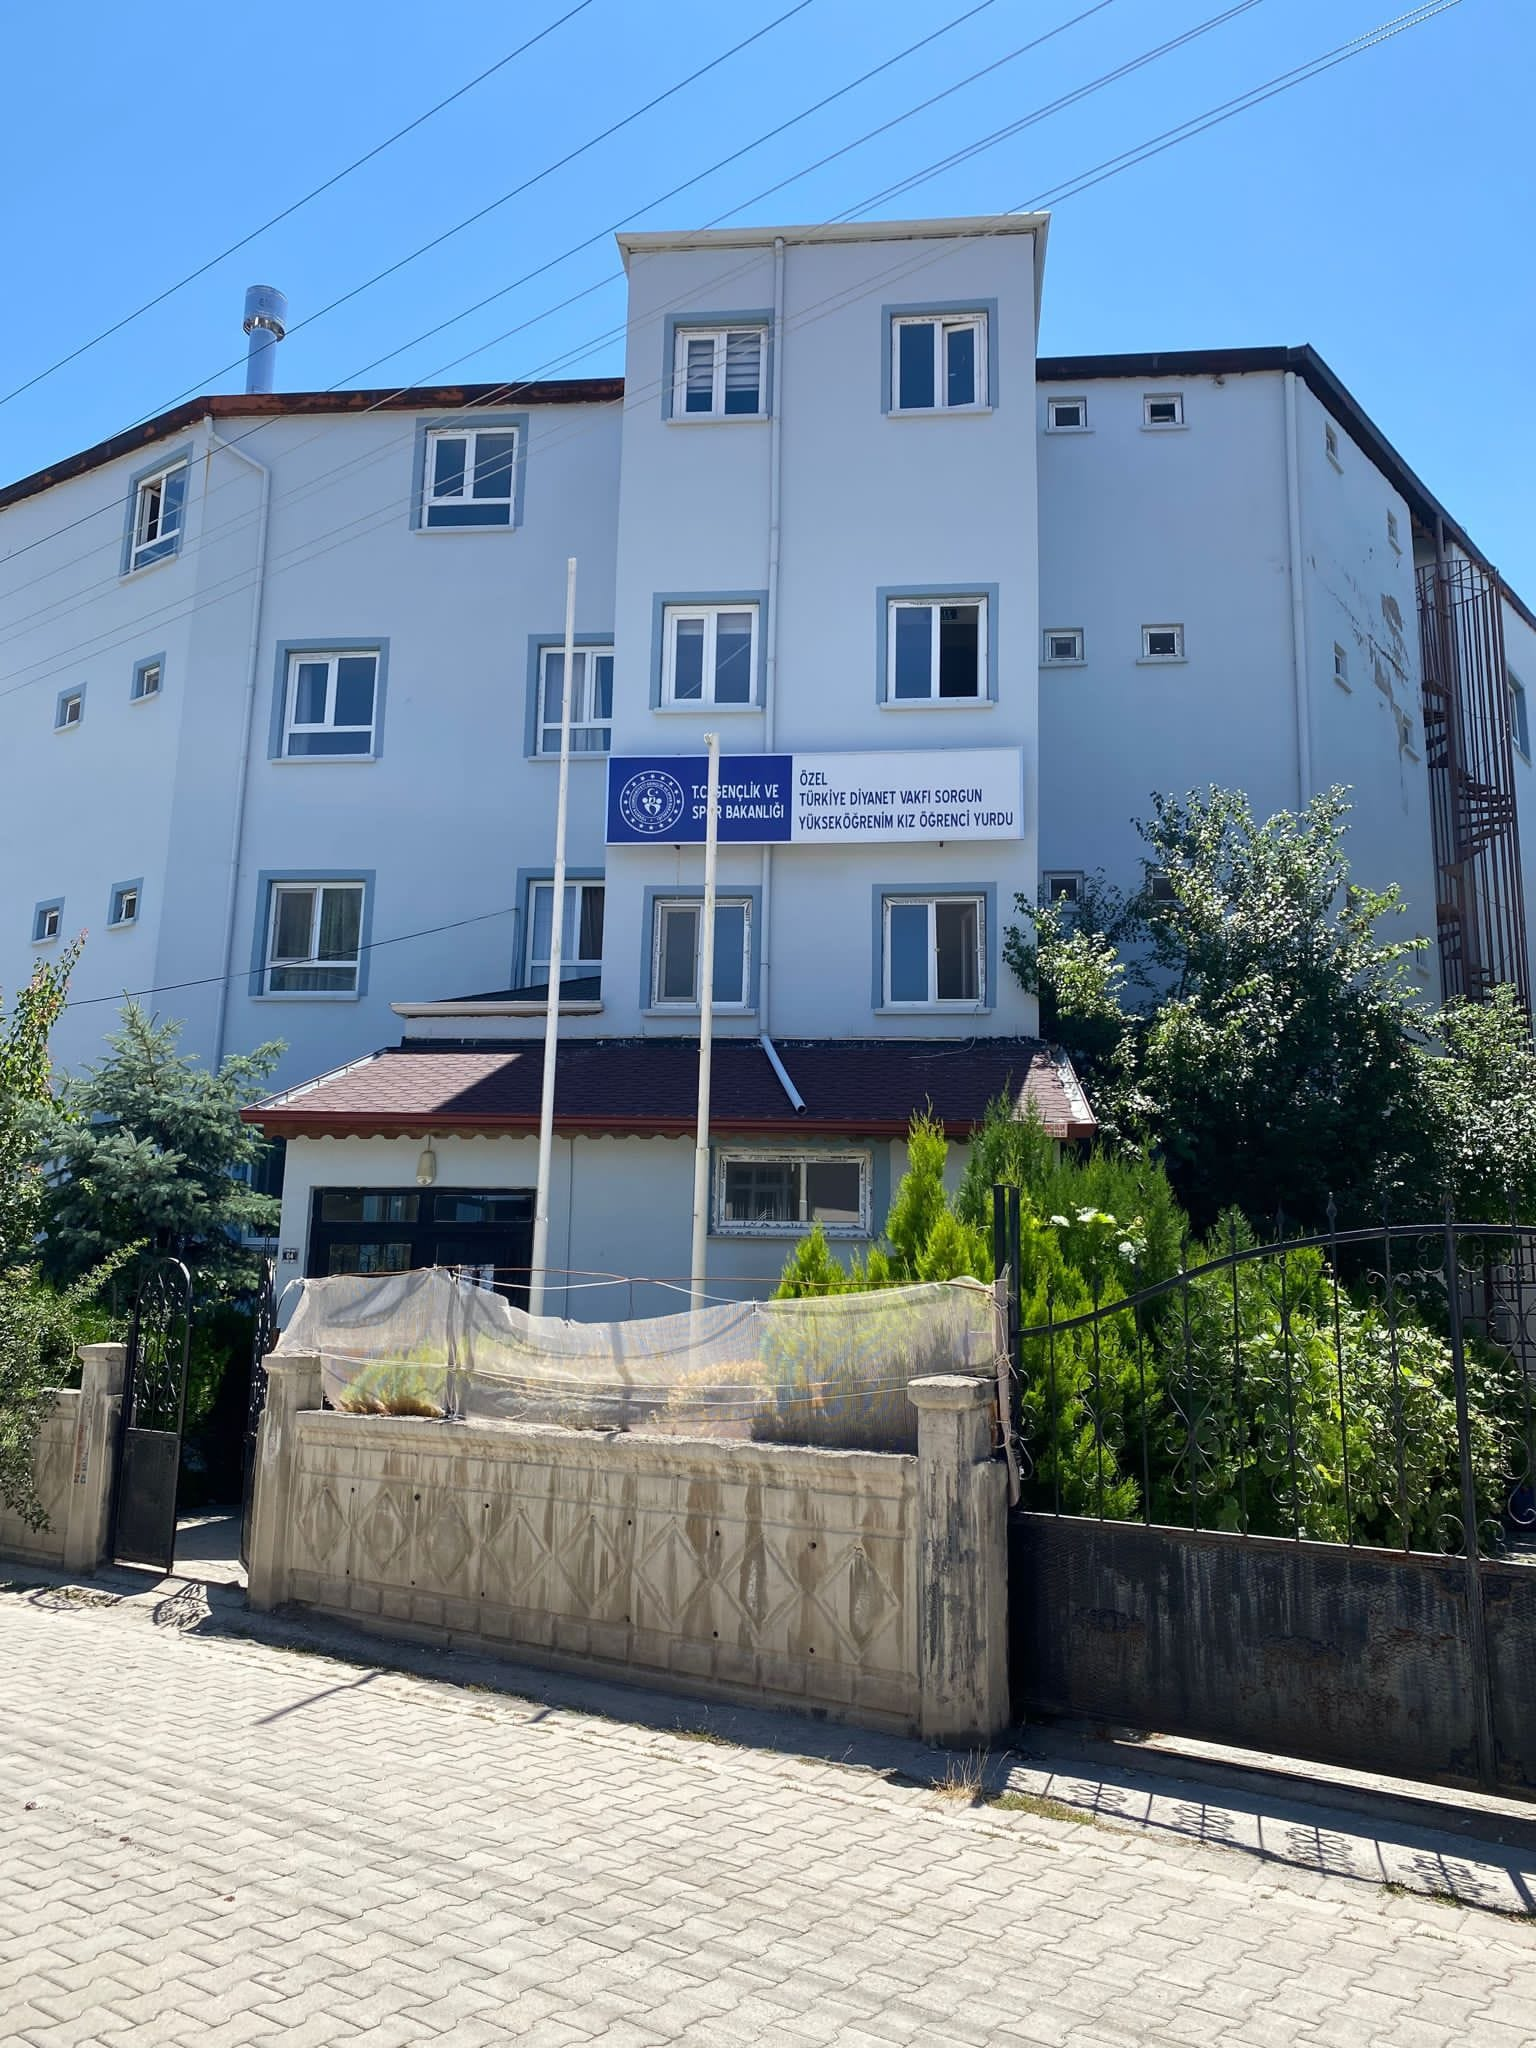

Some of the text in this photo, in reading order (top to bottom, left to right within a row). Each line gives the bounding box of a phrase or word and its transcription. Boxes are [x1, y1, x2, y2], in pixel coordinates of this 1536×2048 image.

[800, 769, 828, 786] ÖZEL
[764, 784, 780, 798] VE
[799, 787, 982, 807] TÜRKİYE DİYANET VAKFI SORGUN
[692, 801, 784, 819] SPR BAKANLIĞI
[799, 809, 1013, 830] YÜKSEKÖĞRENİM KIZ ÖĞRENCİ YURDU
